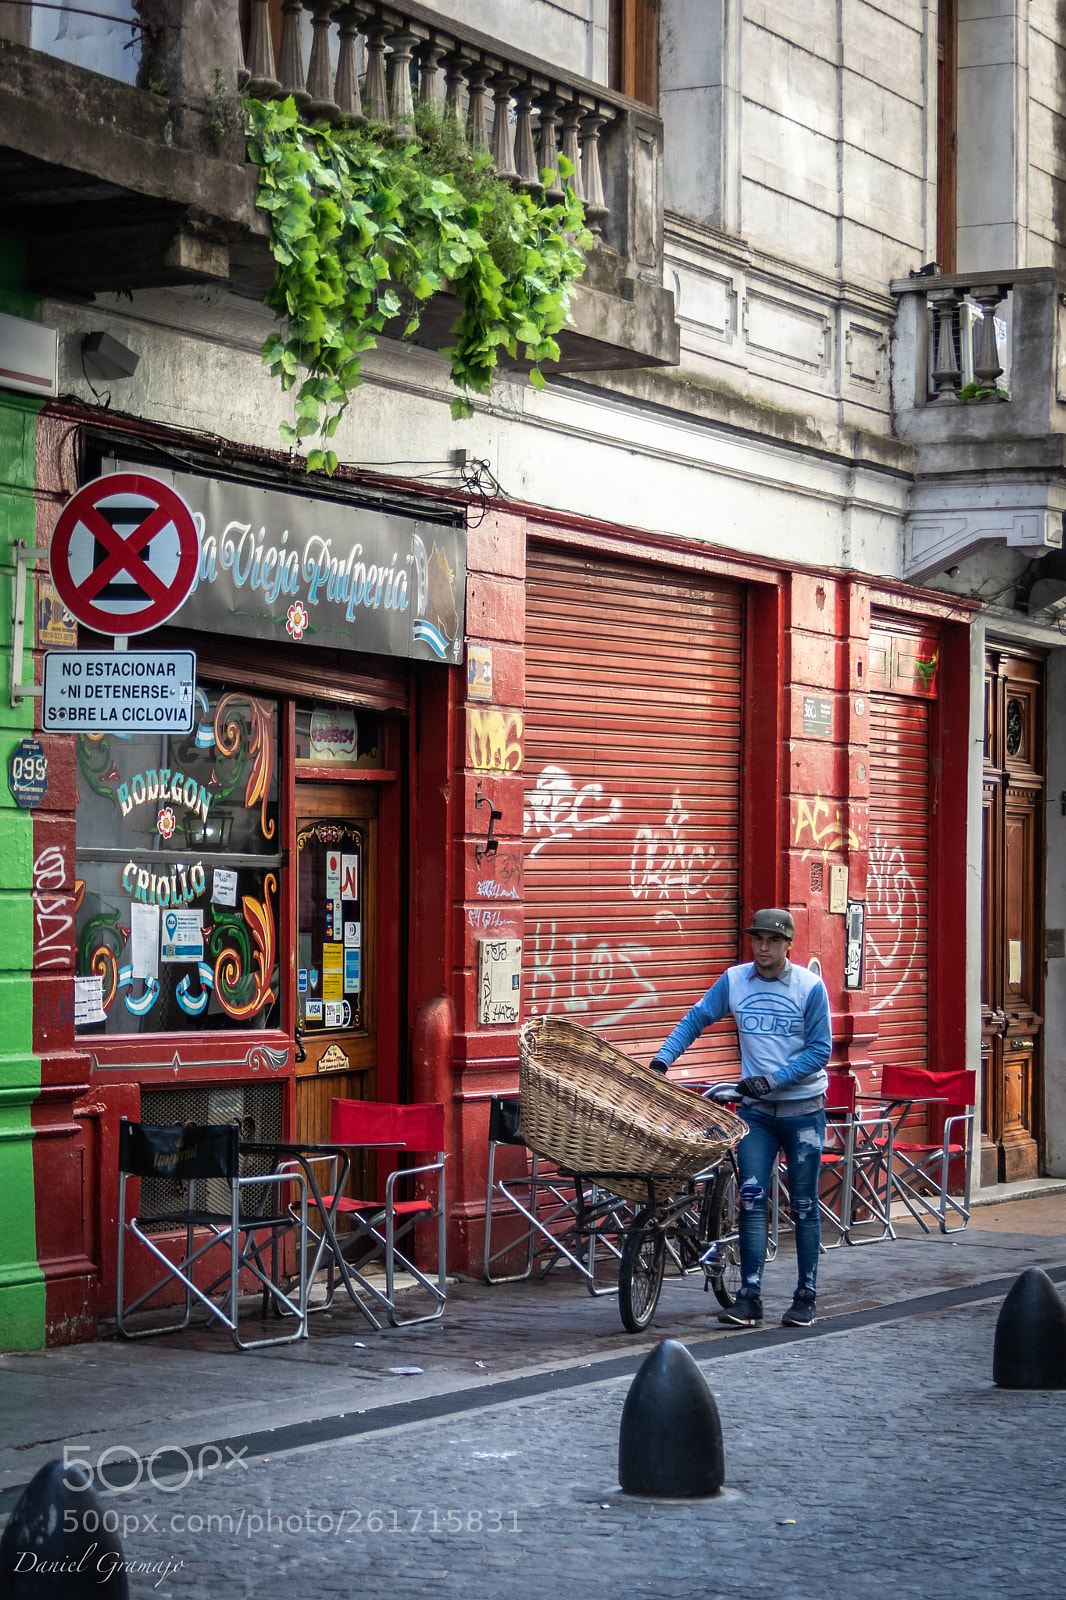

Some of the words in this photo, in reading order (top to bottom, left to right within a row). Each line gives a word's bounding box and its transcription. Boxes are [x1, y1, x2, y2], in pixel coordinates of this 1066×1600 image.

[220, 520, 300, 603] Vieja
[62, 663, 82, 676] NO
[86, 663, 176, 676] ESTACIONAR
[68, 685, 80, 698] NI
[85, 685, 169, 698] DETENERSE
[100, 708, 118, 721] LA
[122, 708, 187, 721] CICLOVIA
[117, 769, 212, 823] BODEGON
[121, 860, 206, 908] CRIOLLO
[308, 1004, 321, 1014] VISA
